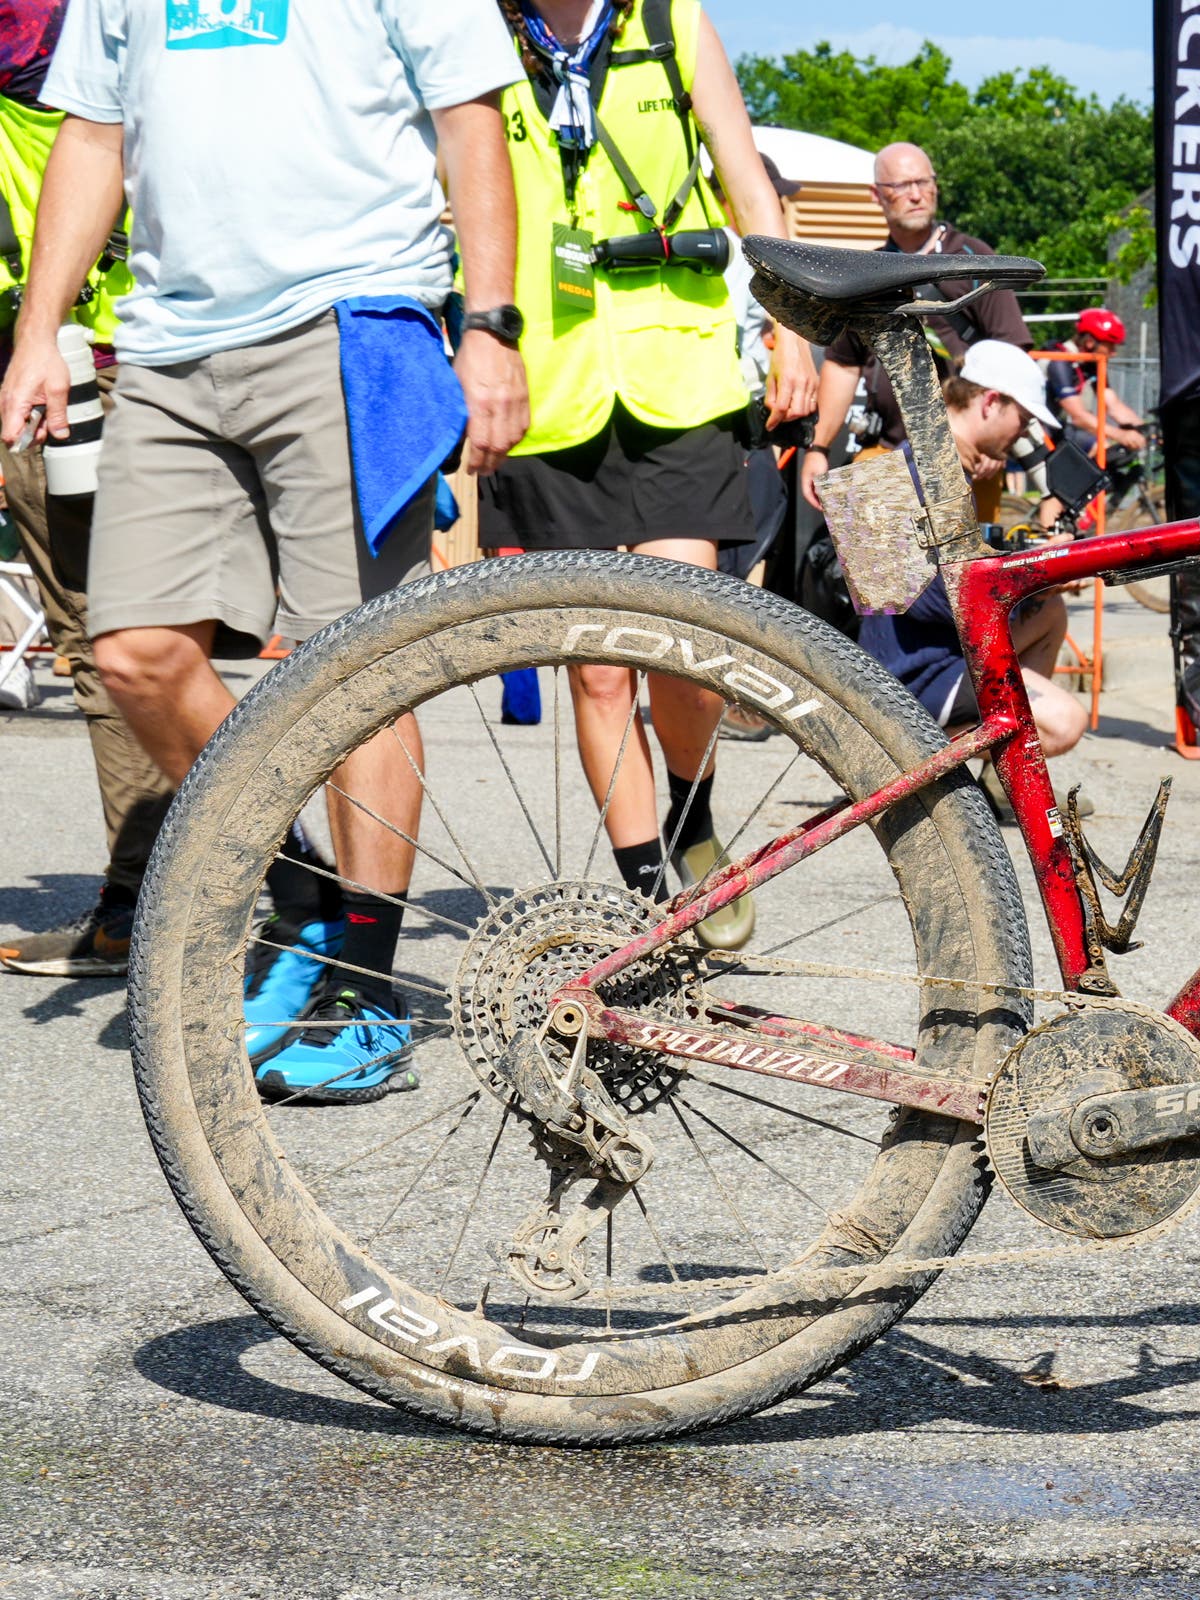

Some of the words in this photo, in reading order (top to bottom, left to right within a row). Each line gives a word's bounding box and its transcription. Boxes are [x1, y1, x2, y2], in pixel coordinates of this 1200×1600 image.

[638, 100, 658, 112] LIFE
[559, 282, 593, 298] MEDIA
[637, 1026, 850, 1082] SPECIALIZED
